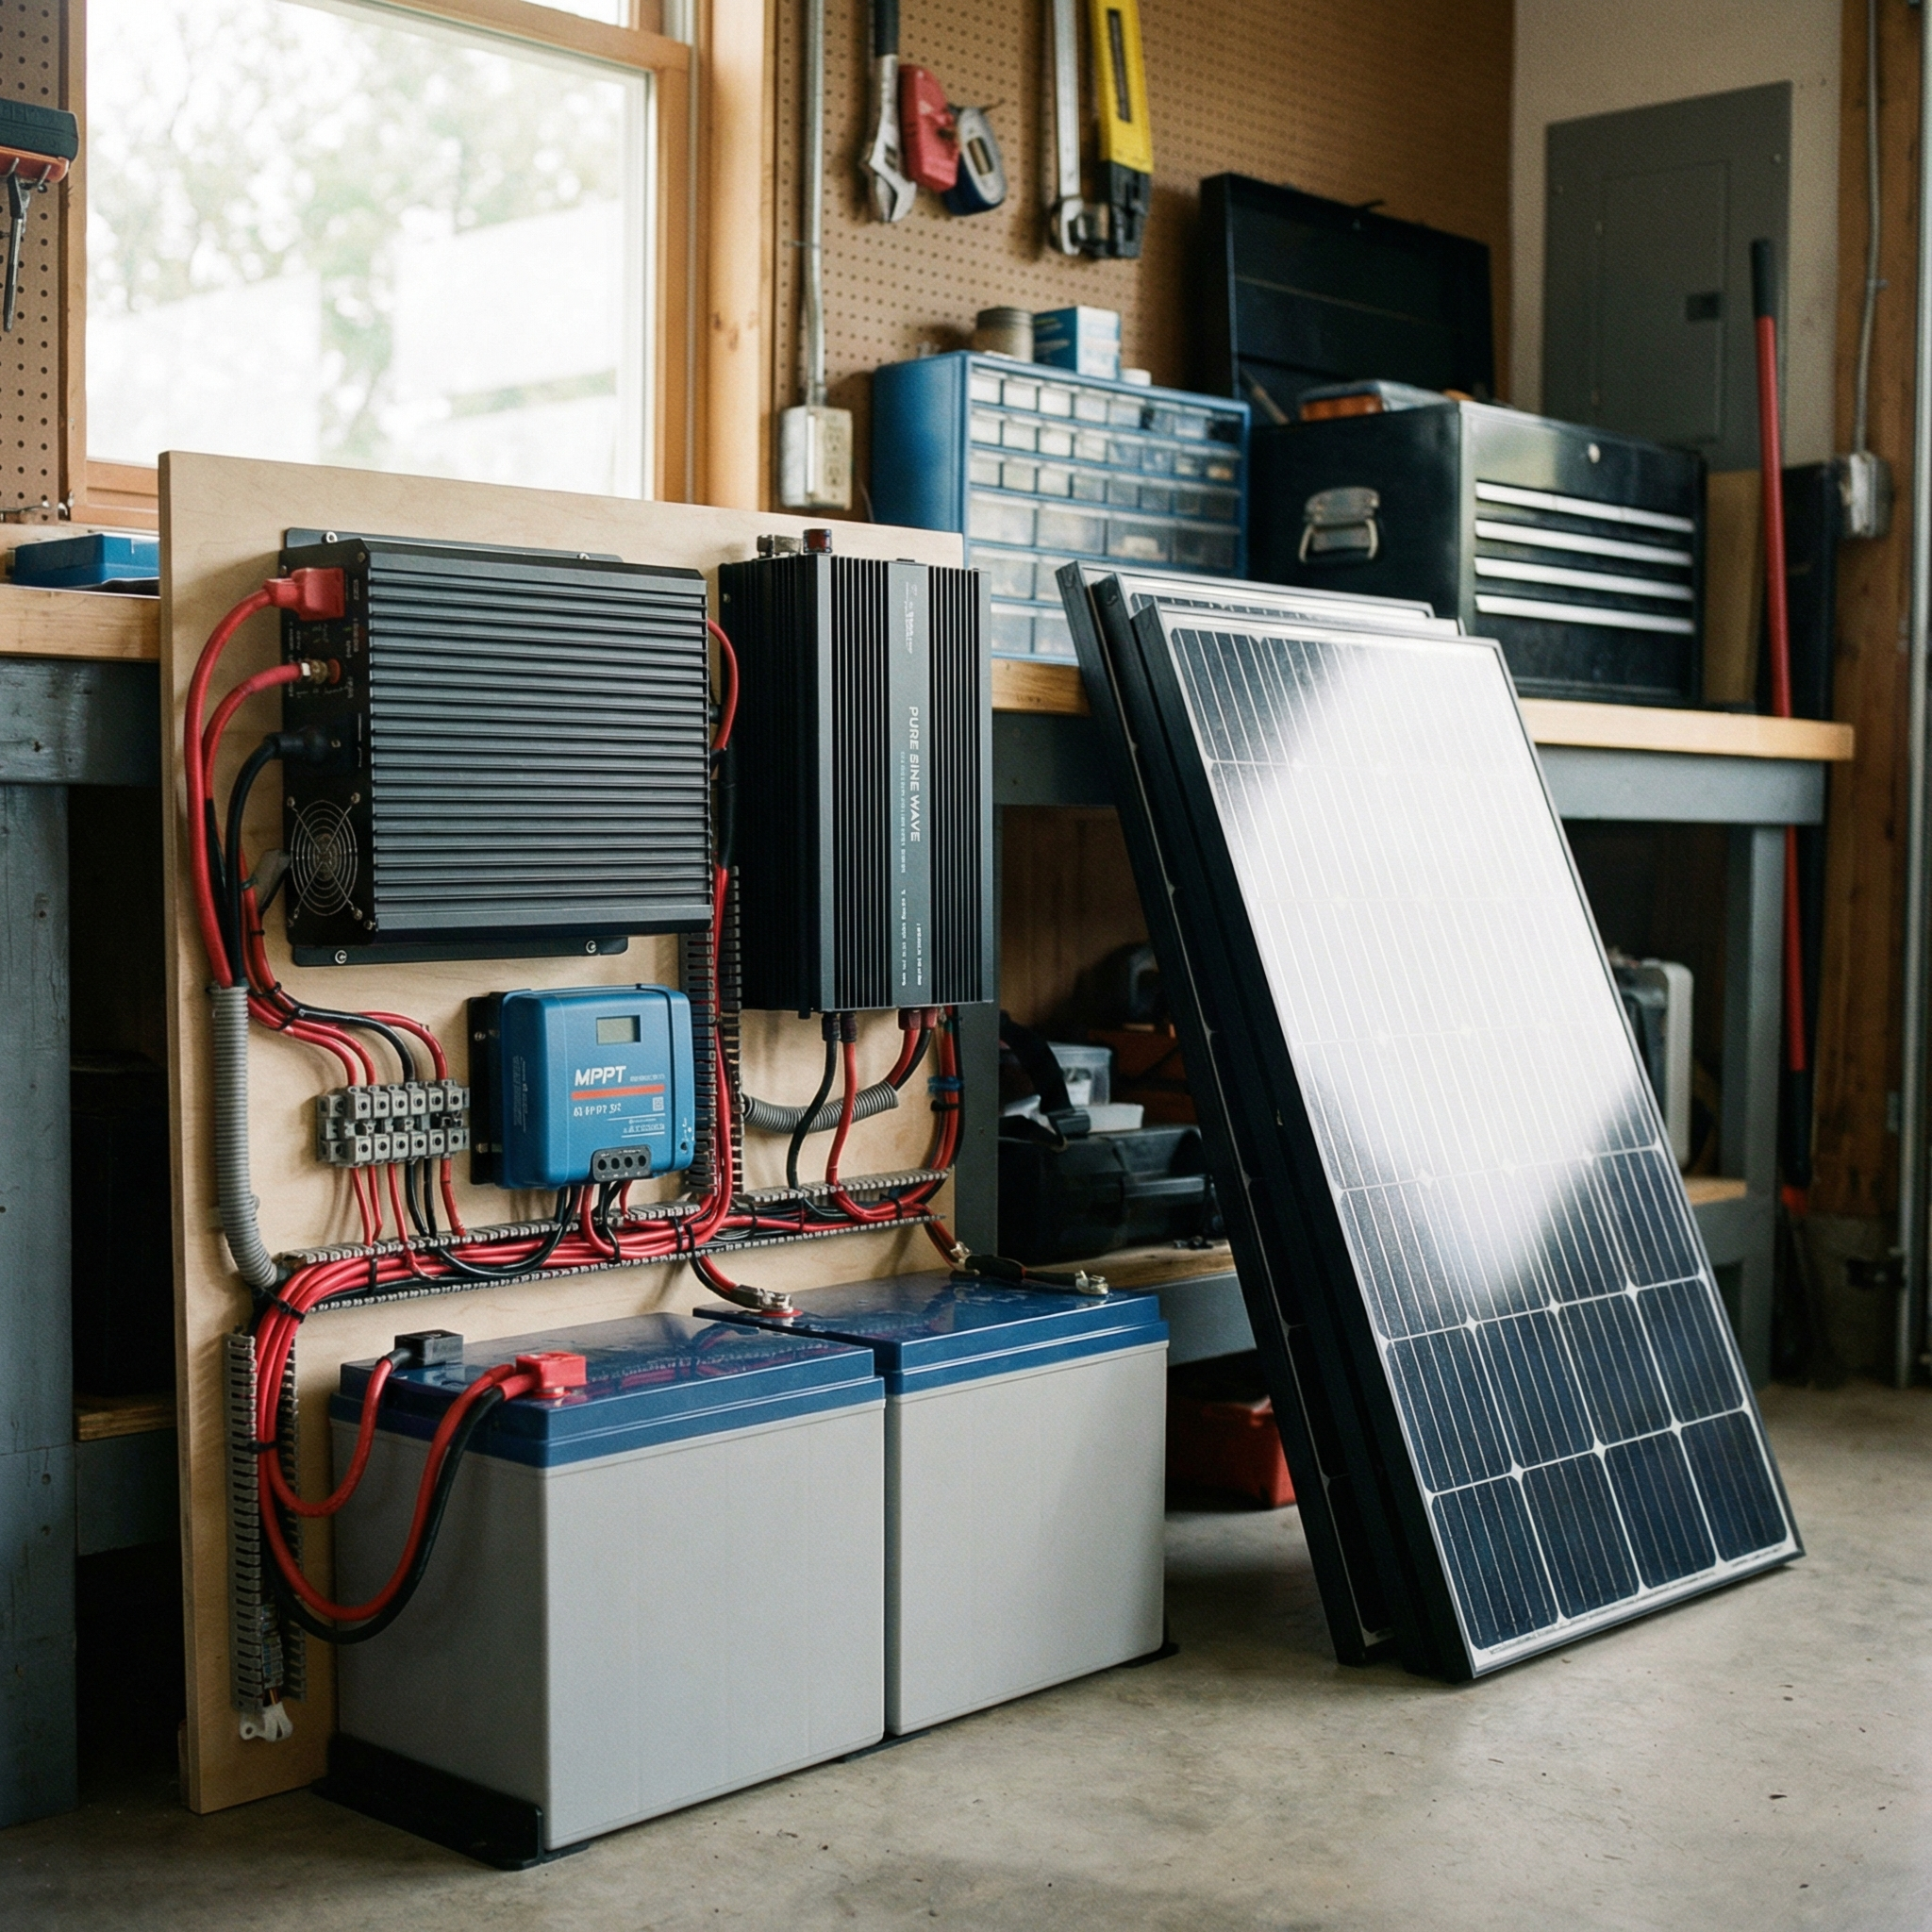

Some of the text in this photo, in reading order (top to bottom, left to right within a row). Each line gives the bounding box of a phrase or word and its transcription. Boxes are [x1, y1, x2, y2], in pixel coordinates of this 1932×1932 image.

[908, 707, 921, 842] PURE SINE WAVE
[575, 1065, 626, 1087] MPPT
